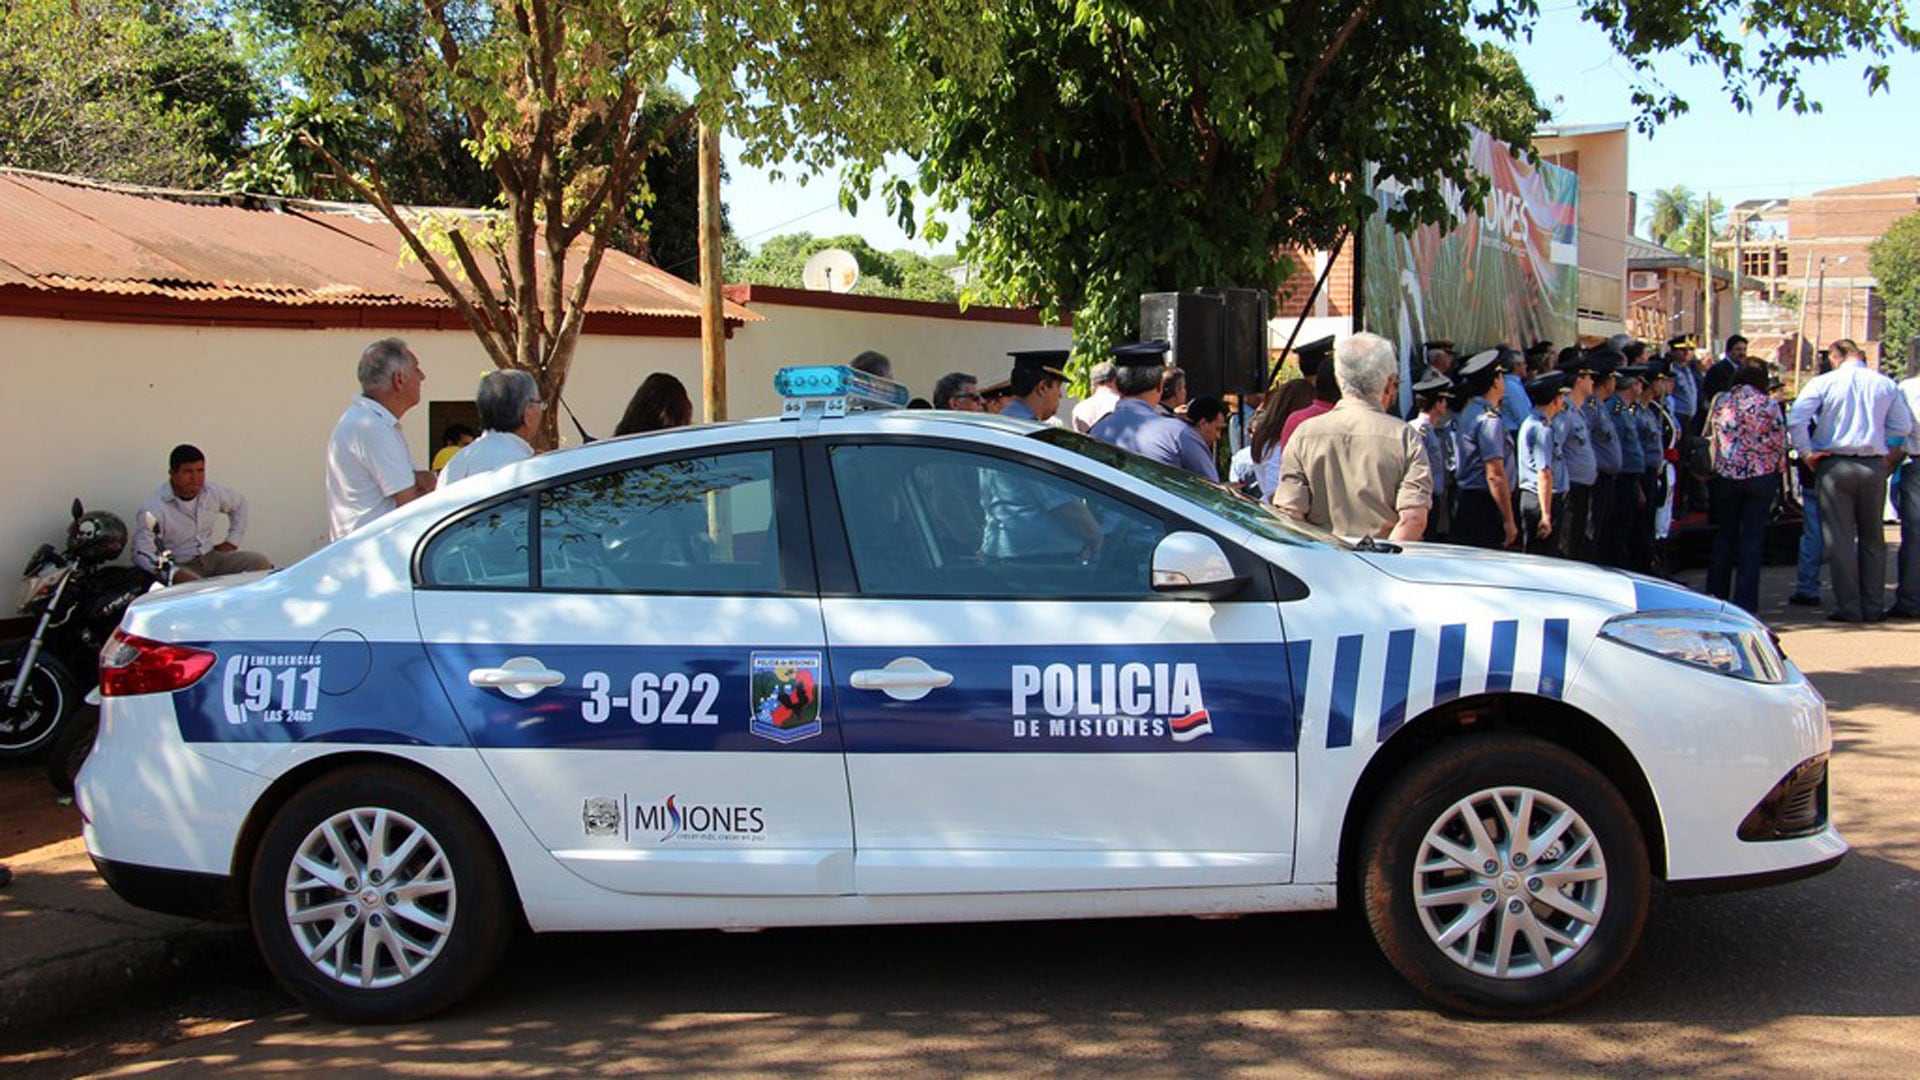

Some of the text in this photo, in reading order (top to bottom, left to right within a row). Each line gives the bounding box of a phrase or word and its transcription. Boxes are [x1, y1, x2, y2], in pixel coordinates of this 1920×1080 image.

[250, 655, 322, 666] EMERGENCIAS
[244, 667, 321, 712] 911
[581, 671, 721, 725] 3-622
[1011, 663, 1205, 716] POLICIA
[263, 710, 283, 723] LAS
[1013, 718, 1165, 737] DE MISIONES
[635, 794, 765, 841] MISIONES
